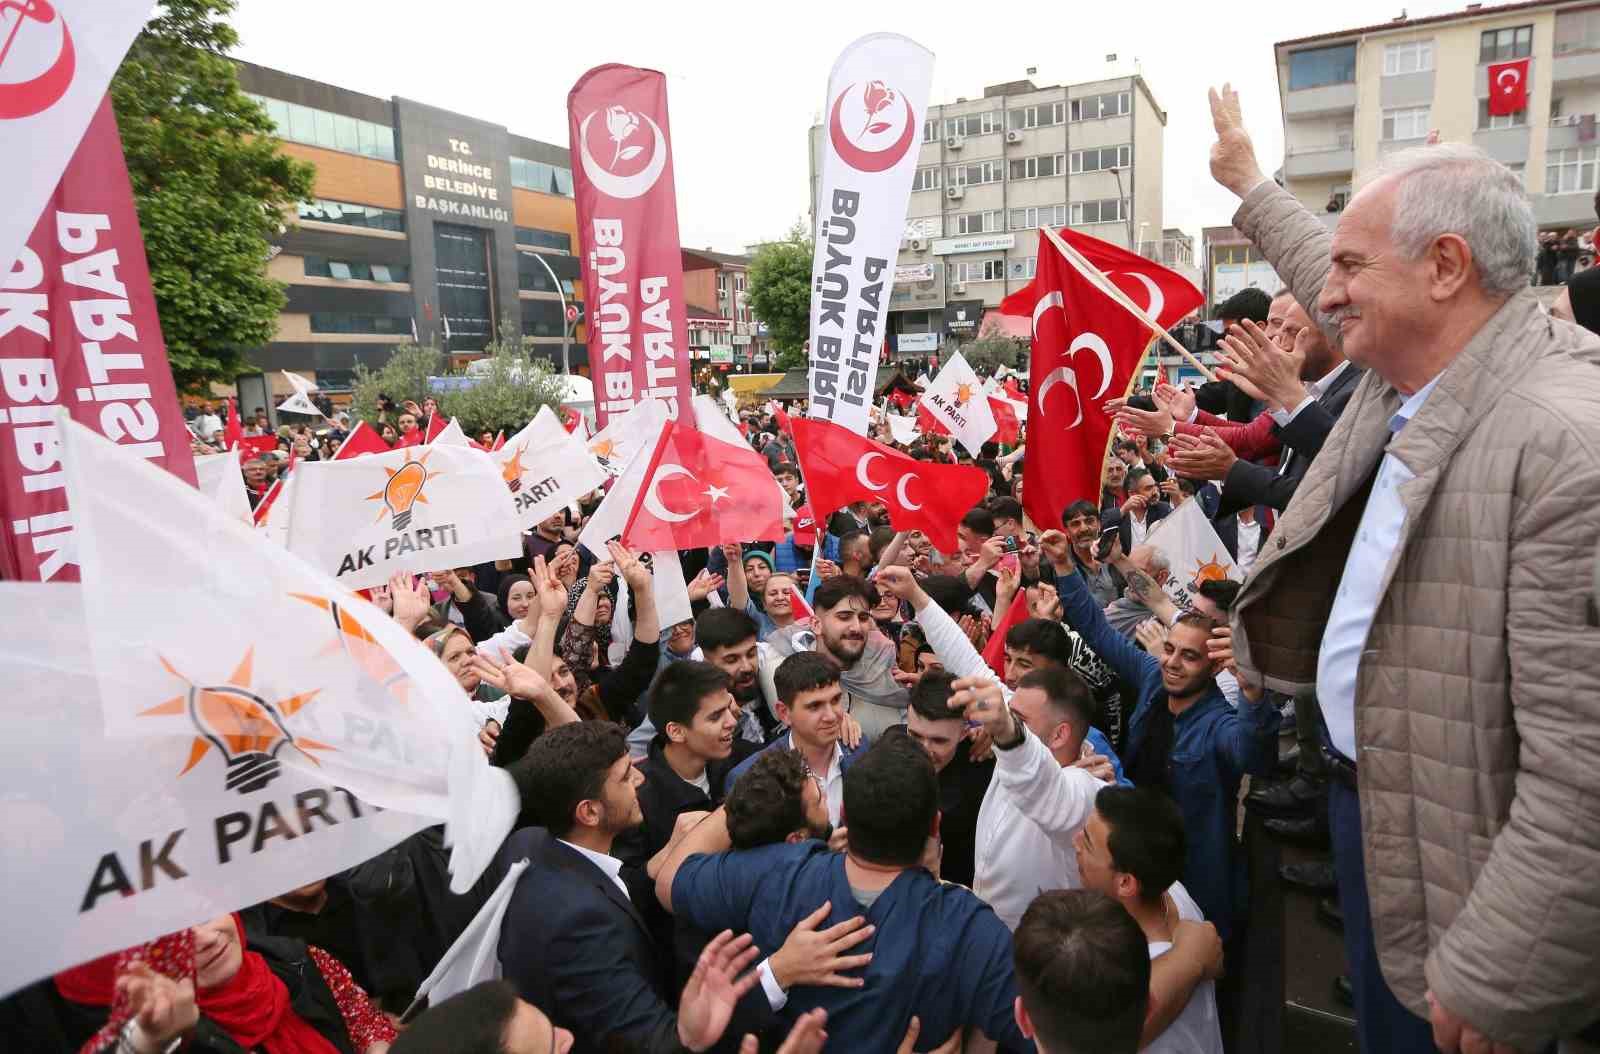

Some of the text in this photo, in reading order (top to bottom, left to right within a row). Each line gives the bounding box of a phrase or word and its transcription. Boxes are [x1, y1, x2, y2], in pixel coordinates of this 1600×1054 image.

[427, 154, 492, 180] DERİNCE
[423, 174, 498, 200] BELEDİYE
[415, 194, 508, 222] BAŞKANLIĞI
[930, 394, 946, 408] AK
[336, 523, 460, 577] AK PARTİ
[78, 786, 384, 914] AK PART
